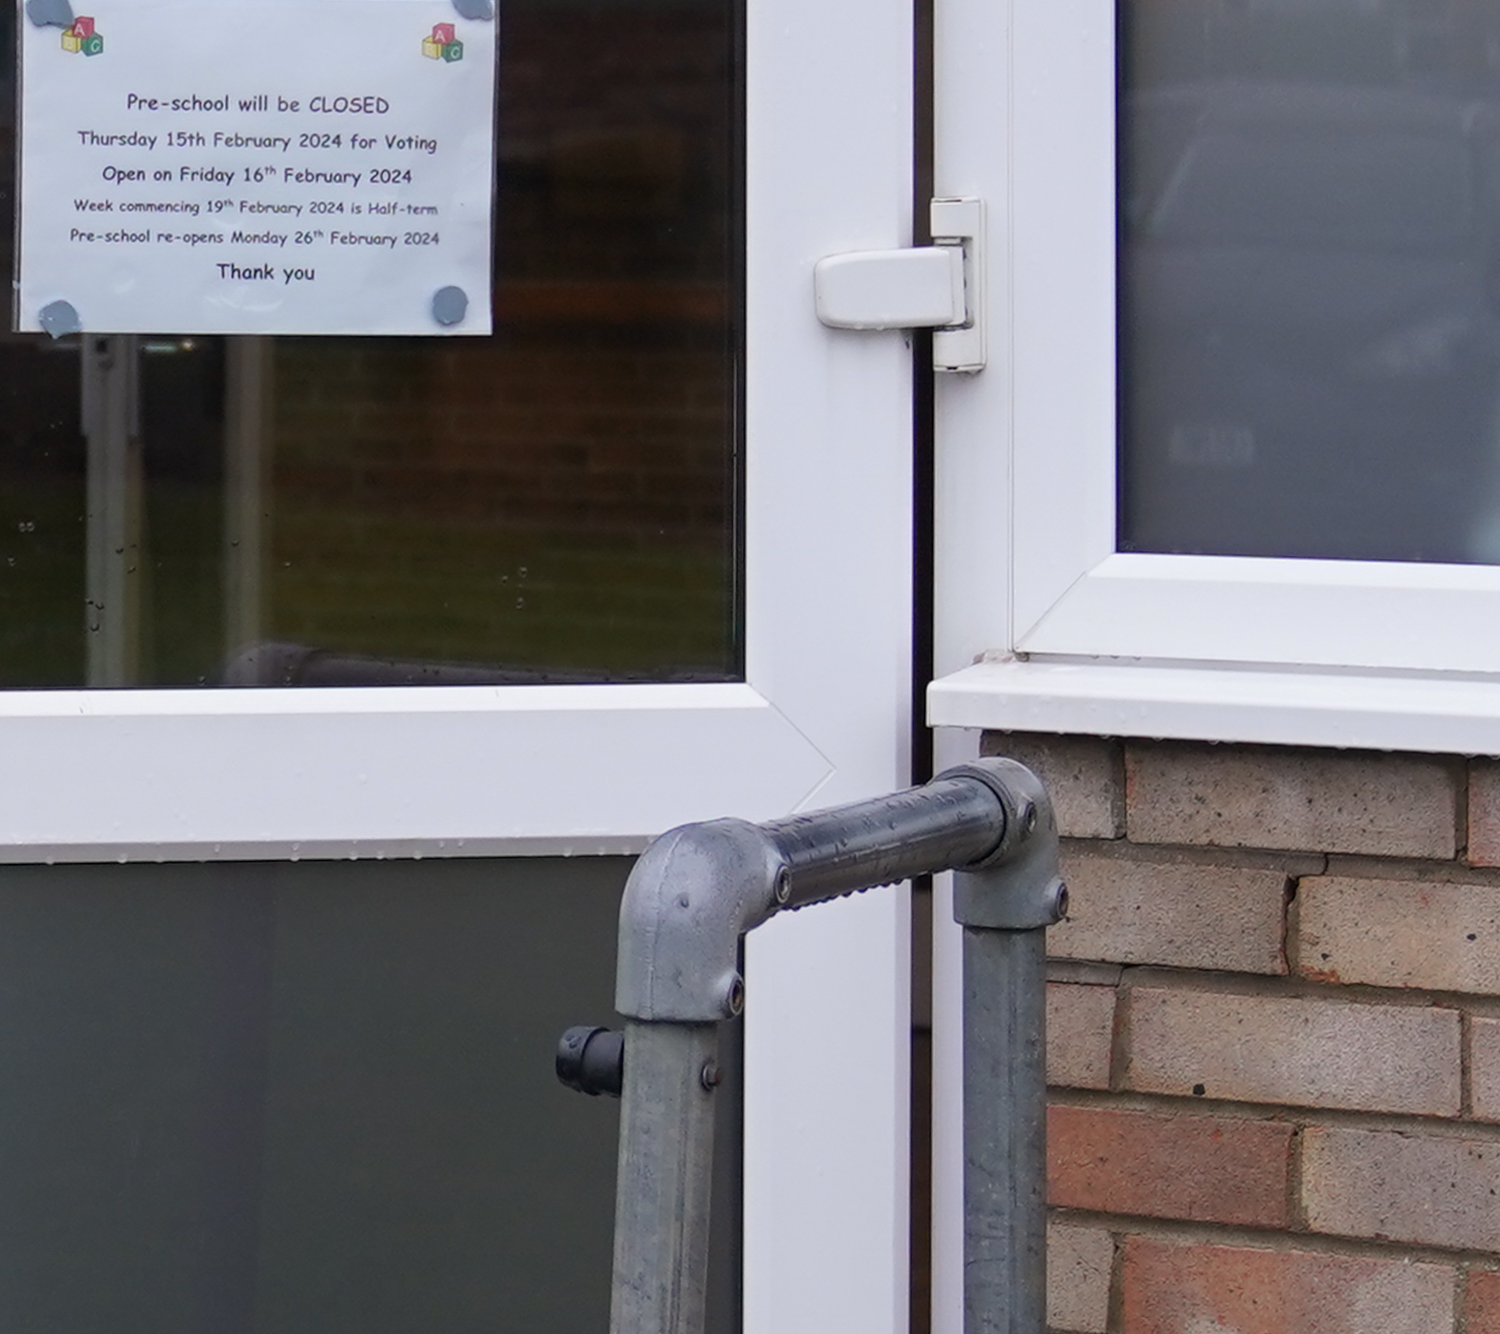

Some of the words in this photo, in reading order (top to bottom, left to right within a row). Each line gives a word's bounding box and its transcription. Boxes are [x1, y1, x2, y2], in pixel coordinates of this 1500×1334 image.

[74, 24, 84, 37] A
[434, 29, 446, 42] A
[128, 93, 229, 112] Pre-school
[239, 95, 268, 112] will
[278, 96, 300, 113] be
[309, 97, 389, 114] CLOSED
[78, 131, 157, 150] Thursday
[167, 132, 206, 147] 15th
[214, 132, 291, 151] February
[300, 133, 342, 149] 2024
[351, 133, 377, 150] for
[385, 135, 437, 154] Voting
[102, 166, 146, 185] Open
[154, 171, 172, 182] on
[180, 167, 235, 186] Friday
[244, 167, 277, 183] 16th
[285, 168, 361, 187] February
[370, 169, 412, 184] 2024
[74, 198, 113, 212] Week
[119, 200, 200, 216] commencing
[207, 199, 234, 213] 19th
[240, 200, 303, 217] February
[309, 201, 344, 215] 2024
[351, 202, 362, 215] is
[369, 202, 438, 216] Half-term
[70, 228, 150, 243] Pre-school
[157, 232, 224, 246] re-opens
[231, 230, 288, 247] Monday
[295, 229, 324, 245] 26th
[330, 231, 397, 249] February
[404, 232, 440, 246] 2024
[217, 262, 274, 280] Thank
[283, 269, 315, 283] you
